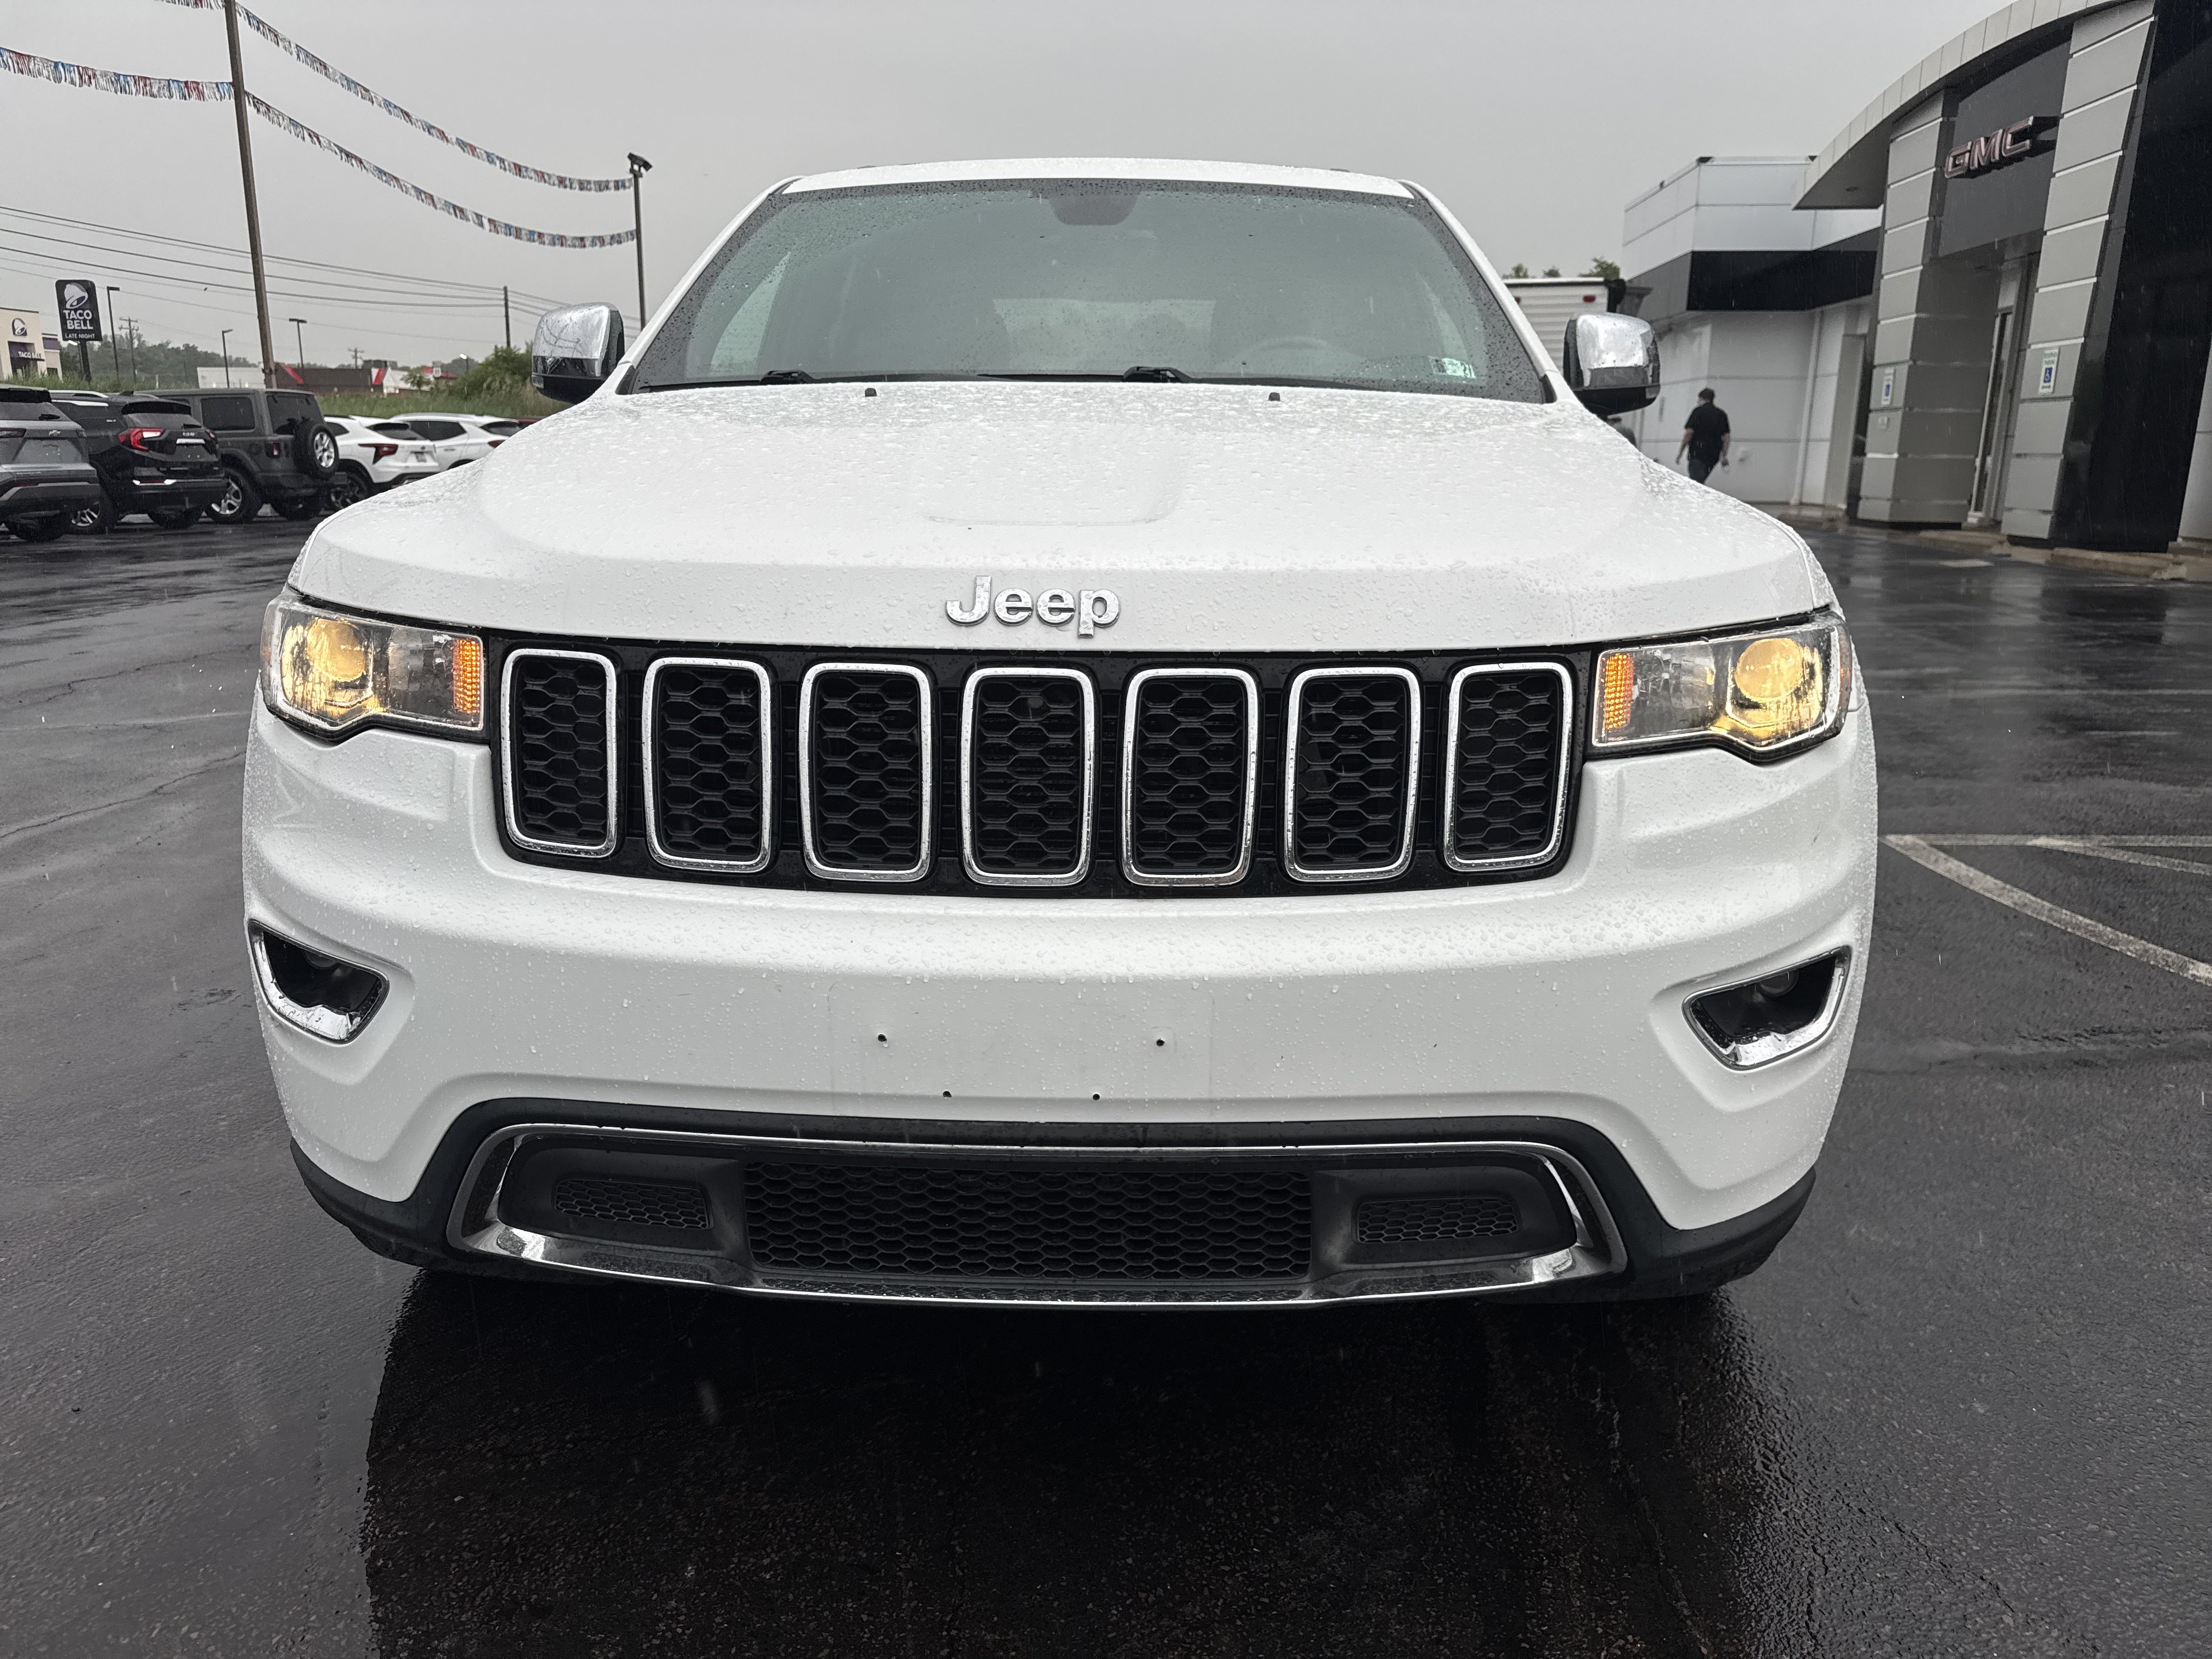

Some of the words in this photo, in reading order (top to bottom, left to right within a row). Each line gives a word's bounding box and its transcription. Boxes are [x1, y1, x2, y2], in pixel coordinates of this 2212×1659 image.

[1945, 116, 2034, 178] GMC
[63, 309, 92, 320] TACO
[66, 320, 94, 330] BELL
[945, 575, 1120, 638] Jeep
